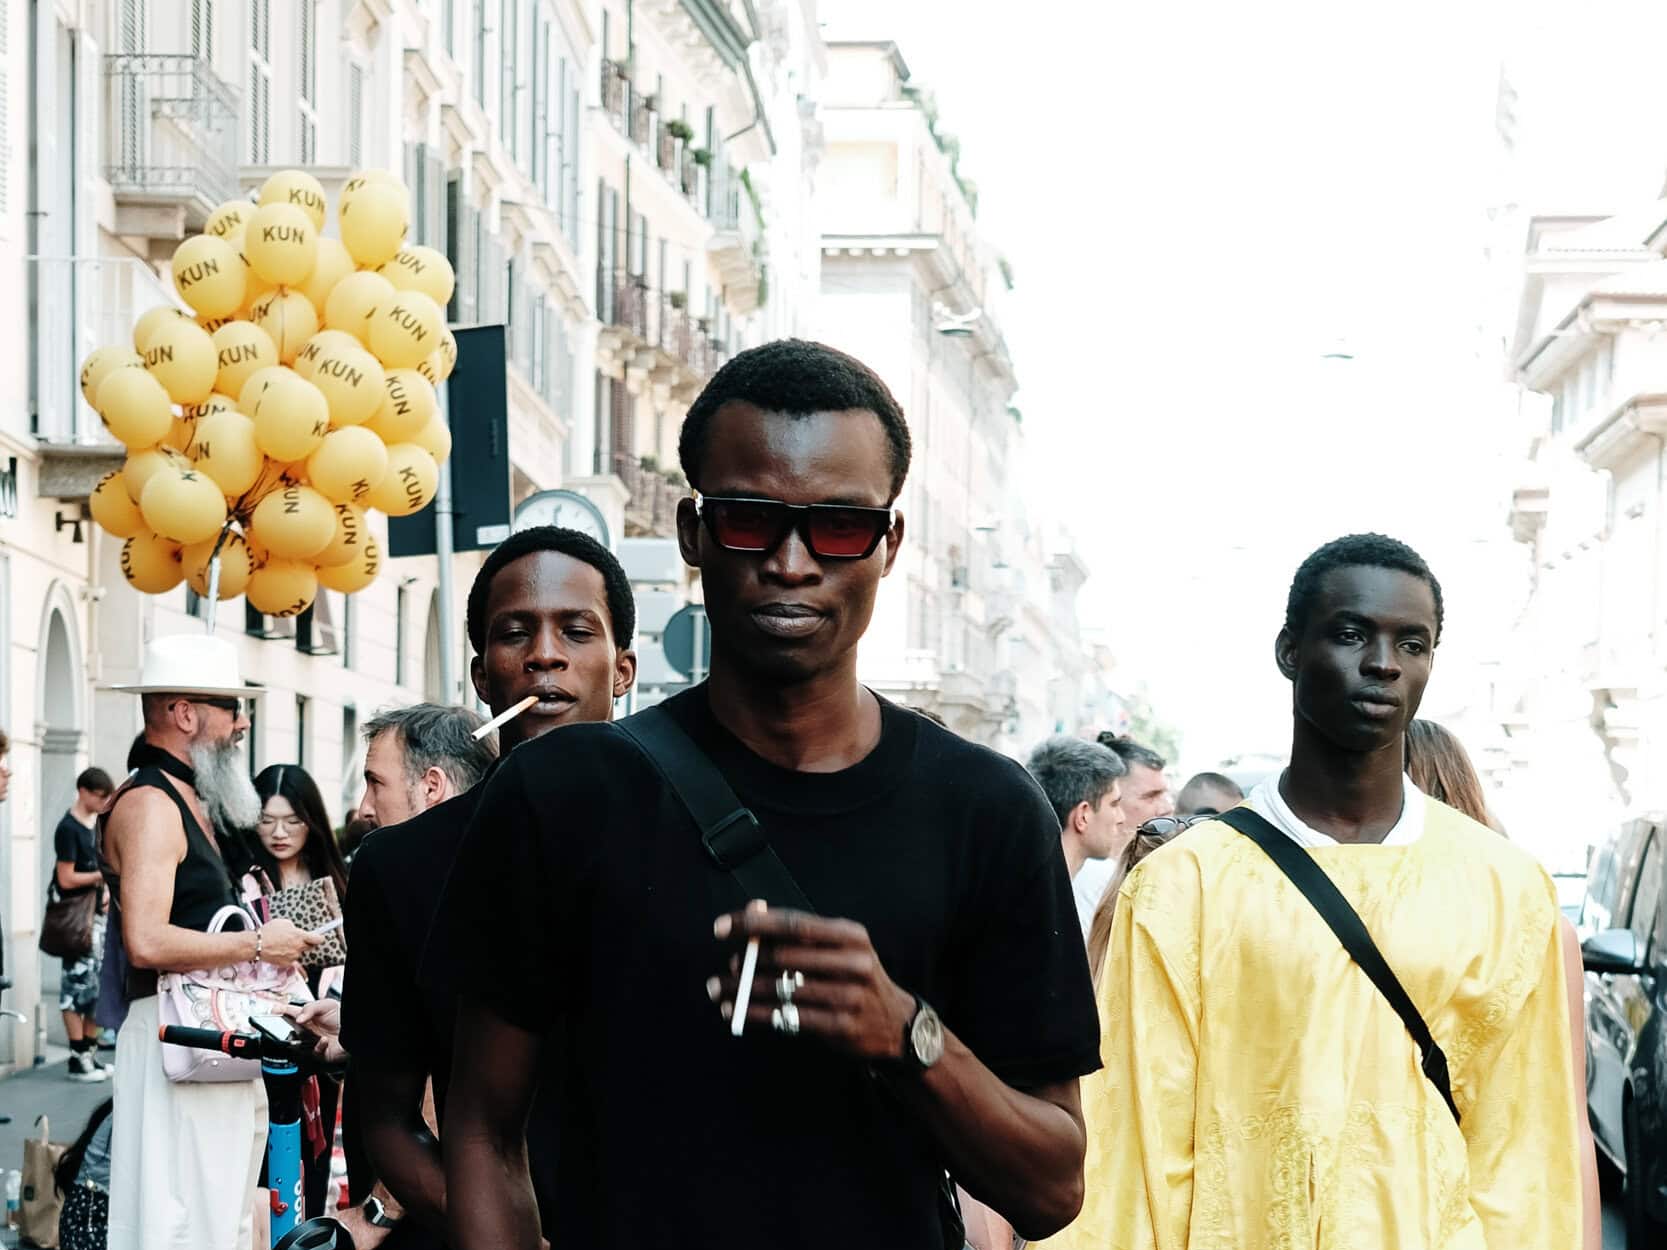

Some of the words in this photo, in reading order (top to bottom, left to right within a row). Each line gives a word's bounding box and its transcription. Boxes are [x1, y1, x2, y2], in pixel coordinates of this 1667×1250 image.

[289, 188, 325, 213] KUN
[211, 211, 242, 237] UN
[263, 226, 305, 245] KUN
[177, 258, 220, 290] KUN
[389, 306, 428, 342] KUN
[144, 345, 174, 369] UN
[218, 343, 258, 370] KUN
[318, 358, 364, 388] KUN
[385, 375, 411, 416] KUN
[399, 466, 425, 509] KUN
[335, 503, 358, 546] KUN
[364, 540, 378, 576] UN
